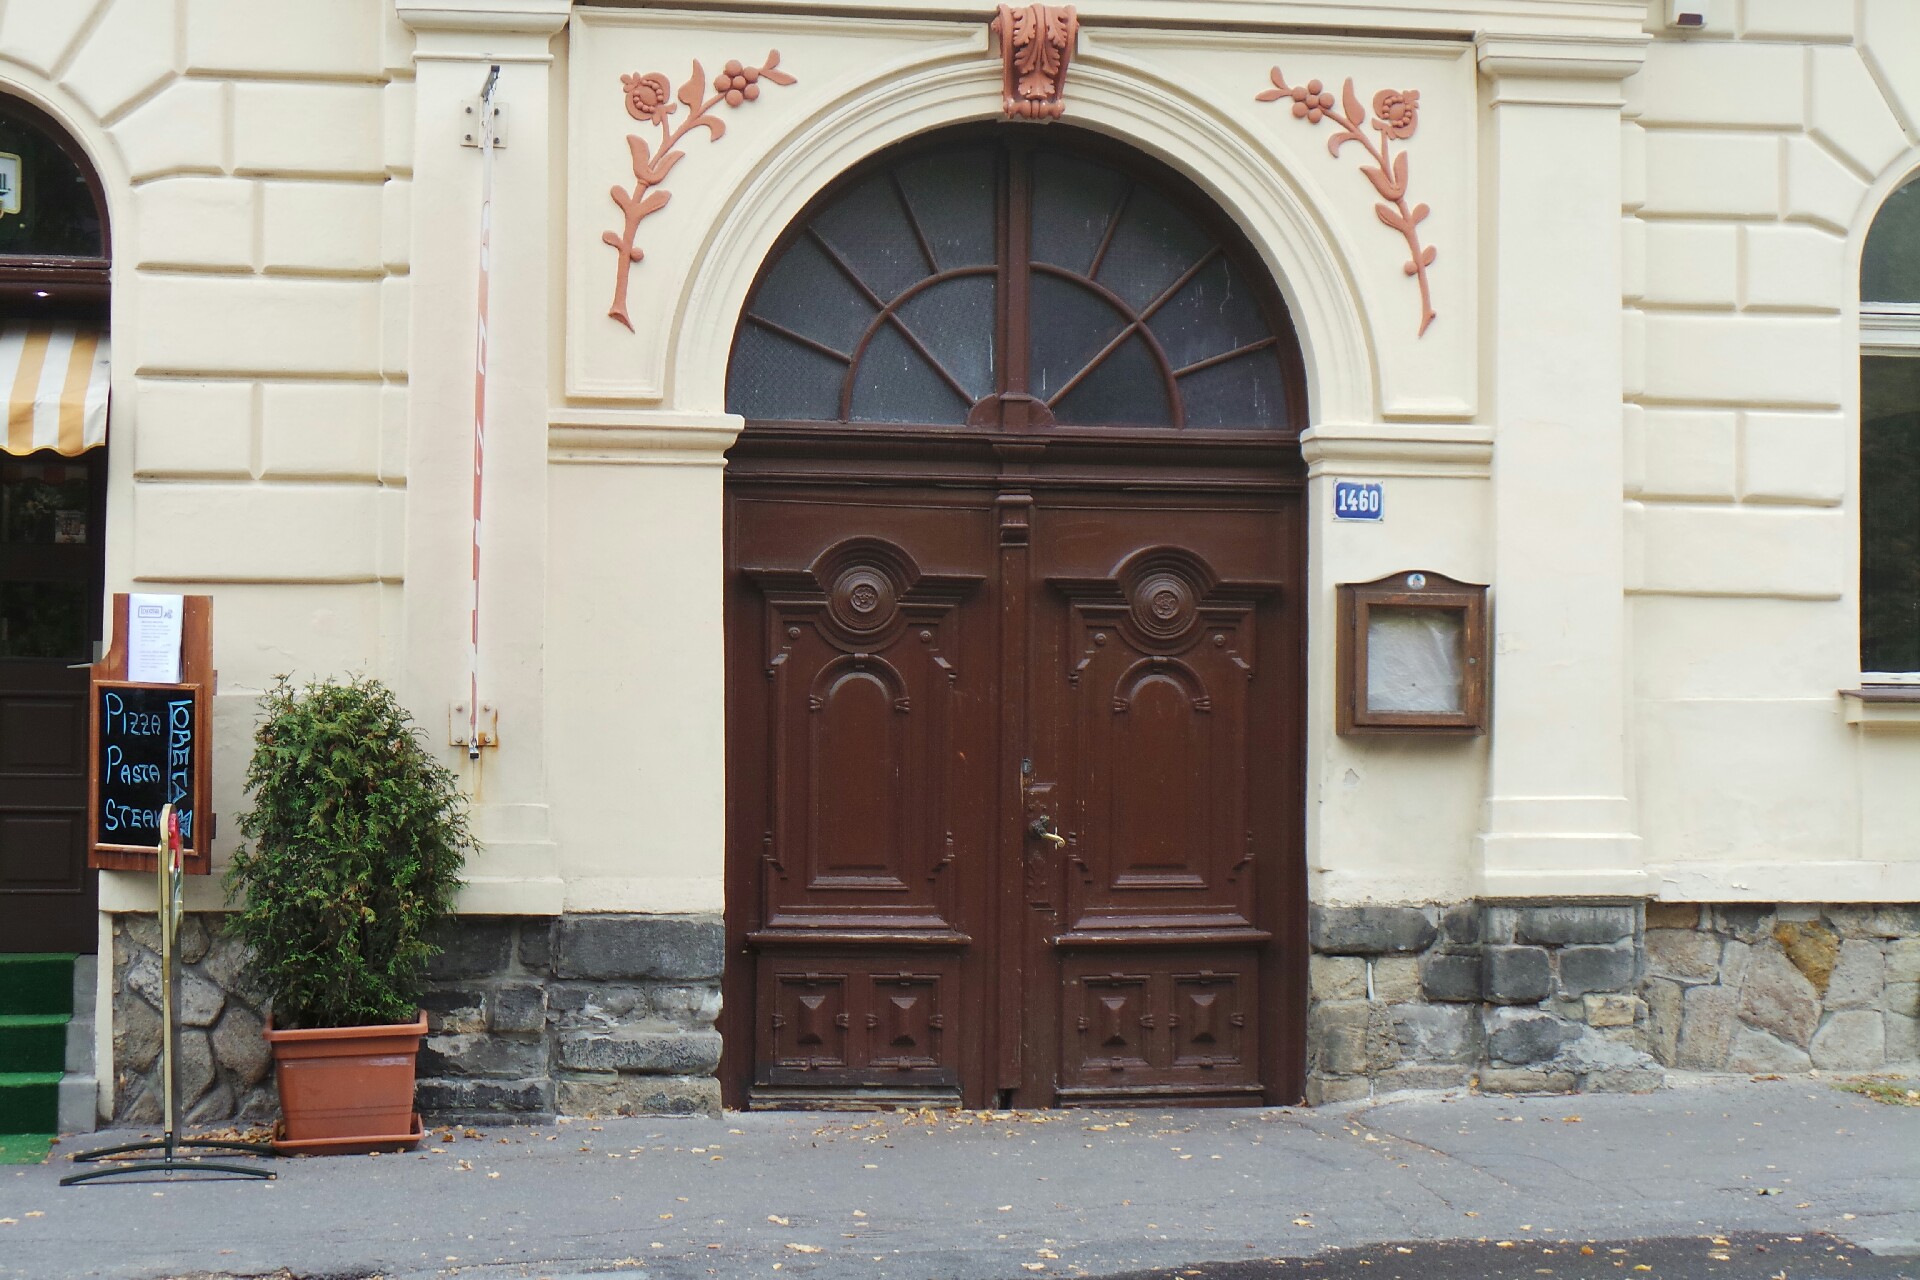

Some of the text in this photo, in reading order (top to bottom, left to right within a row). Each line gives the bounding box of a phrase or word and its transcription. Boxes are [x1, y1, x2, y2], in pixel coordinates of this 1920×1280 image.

[1339, 489, 1379, 512] 1460
[106, 693, 161, 735] PIZZA
[106, 745, 161, 785] PASTA
[167, 699, 192, 804] LORETA
